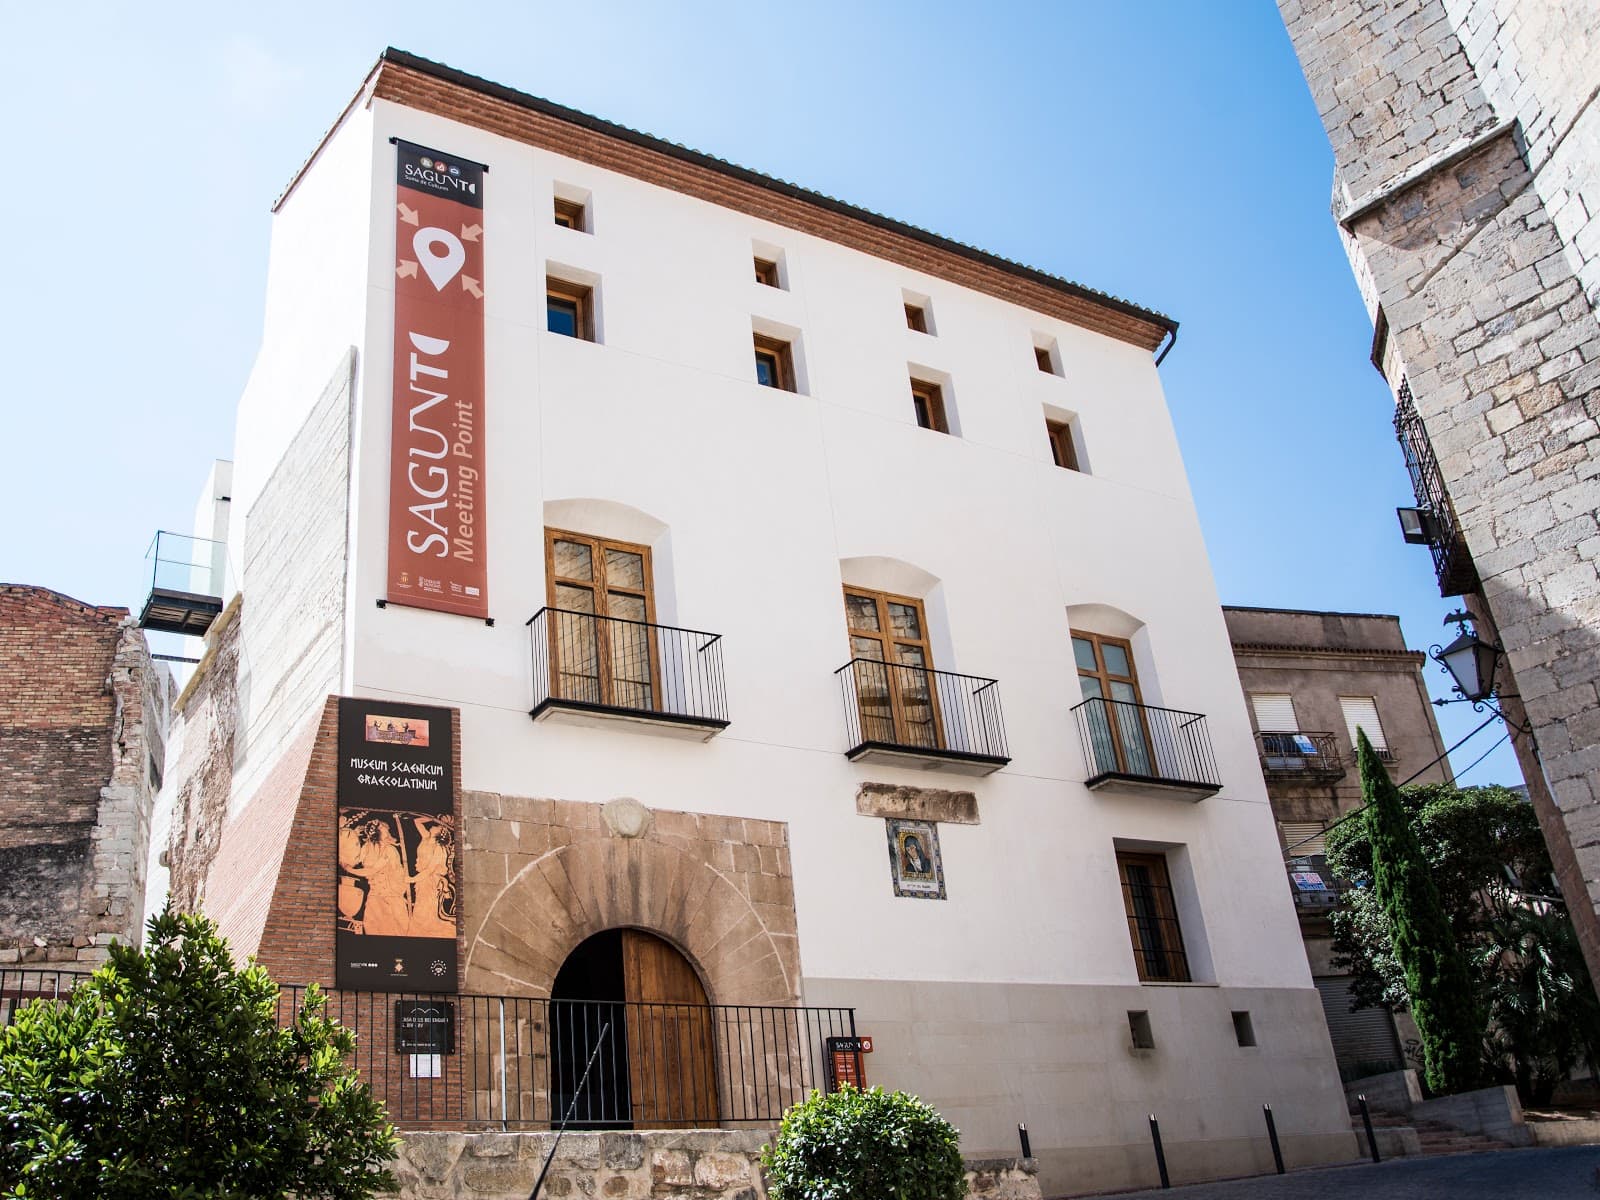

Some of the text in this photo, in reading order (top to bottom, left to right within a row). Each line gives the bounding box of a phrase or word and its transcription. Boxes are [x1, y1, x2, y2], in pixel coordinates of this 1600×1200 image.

[452, 400, 474, 460] Point
[452, 464, 479, 563] Meeting
[350, 758, 443, 776] MUSEUM SCAENICUM
[357, 774, 438, 791] GRAECOLATINUM
